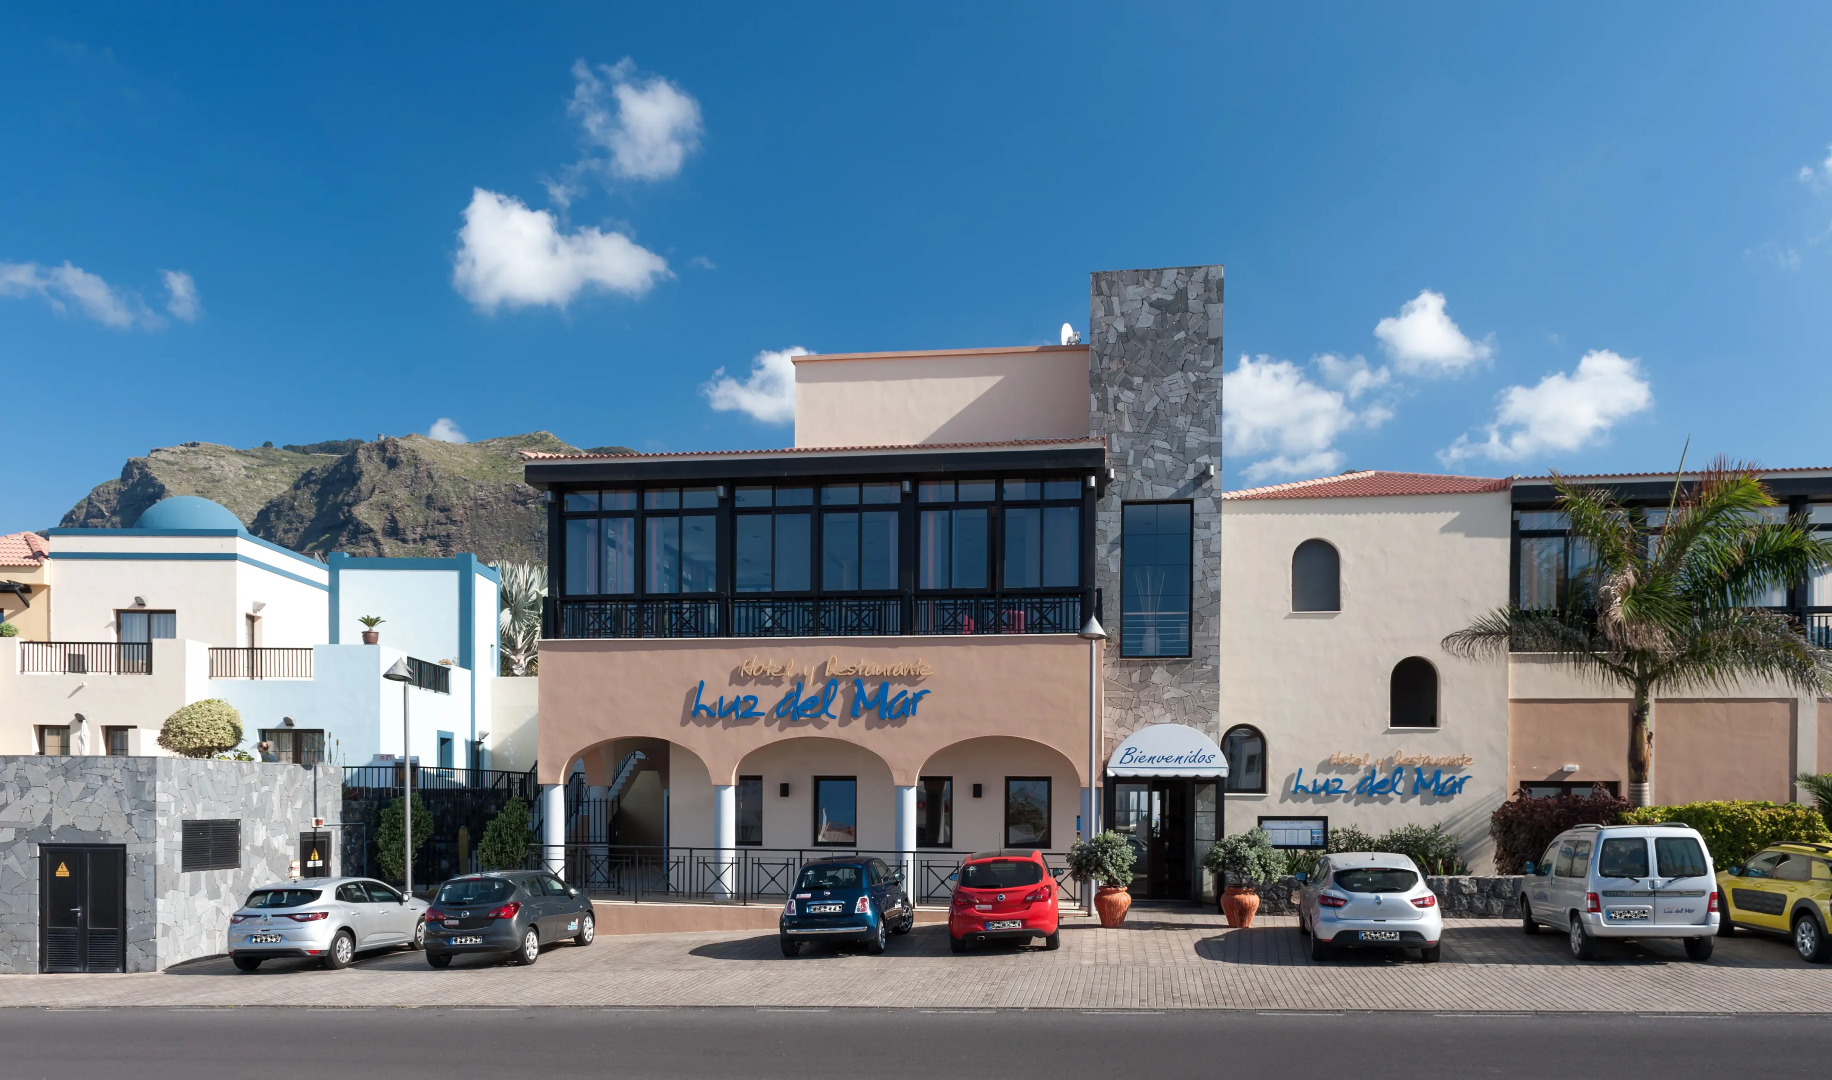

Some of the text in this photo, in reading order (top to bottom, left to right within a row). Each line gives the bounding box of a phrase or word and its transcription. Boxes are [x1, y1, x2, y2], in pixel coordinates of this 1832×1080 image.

[739, 655, 935, 686] Hotel y Restaurante
[692, 678, 932, 721] Luz del Mar
[1118, 746, 1216, 765] Bienvenidos
[1329, 750, 1475, 773] Hotel y Restaurante
[1293, 767, 1474, 797] Luz del Mar
